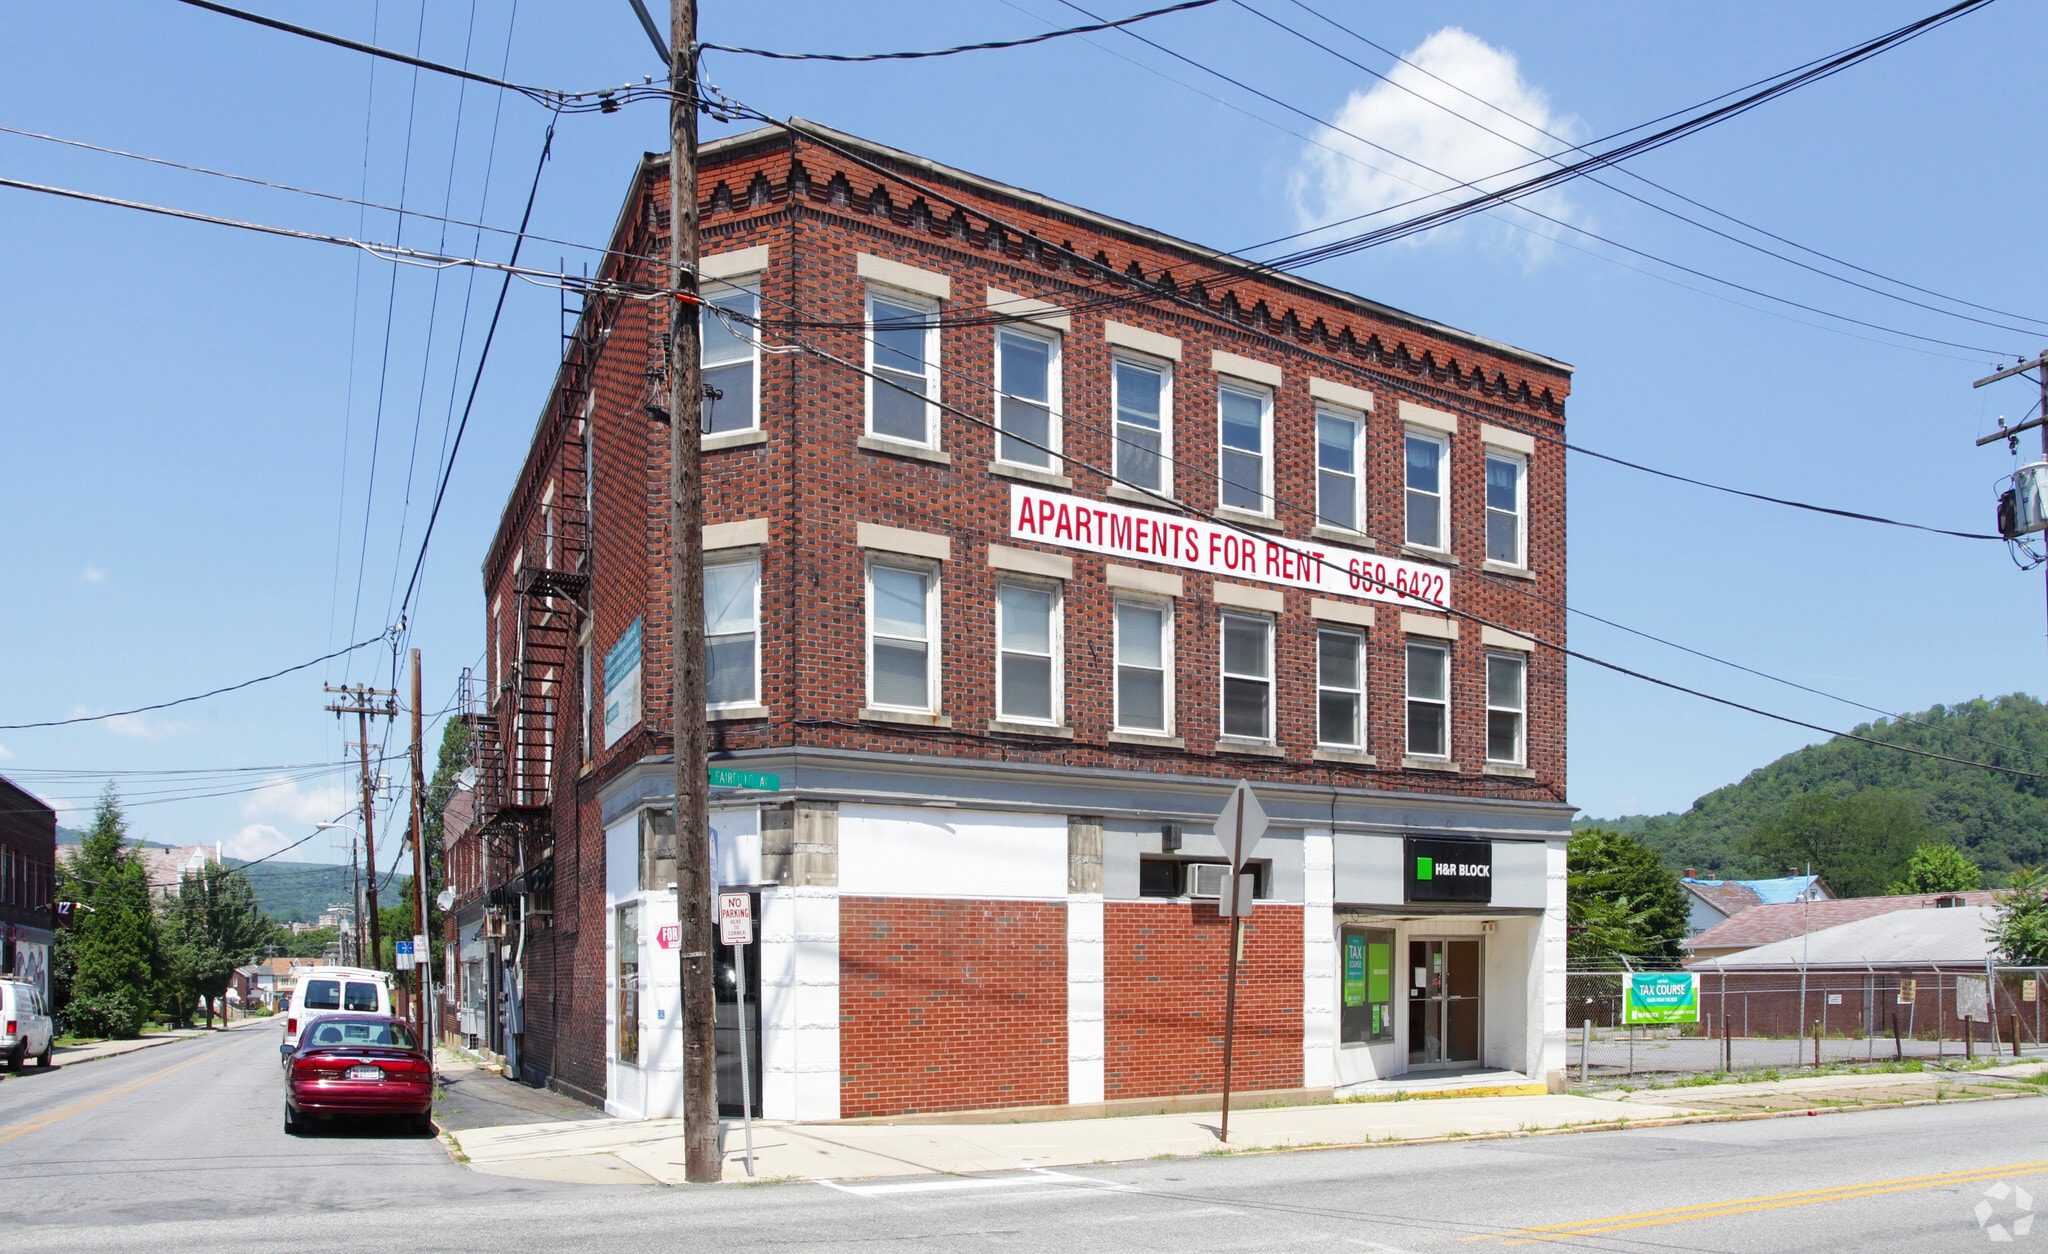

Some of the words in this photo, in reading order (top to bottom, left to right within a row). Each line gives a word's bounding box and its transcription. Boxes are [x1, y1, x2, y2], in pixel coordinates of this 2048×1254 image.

[1018, 496, 1199, 562] APARTMENTS
[1209, 532, 1256, 572] FOR
[1266, 541, 1324, 584] RENT
[1349, 558, 1444, 606] 659-6422
[1435, 863, 1456, 876] H&R
[1459, 864, 1490, 877] BLOCK
[728, 898, 741, 907] NO
[722, 908, 749, 918] PARKING
[662, 927, 678, 941] FOR
[1349, 945, 1362, 959] TAX
[1349, 961, 1362, 969] COURSE
[1639, 985, 1654, 995] TAX
[1656, 984, 1686, 995] COURSE
